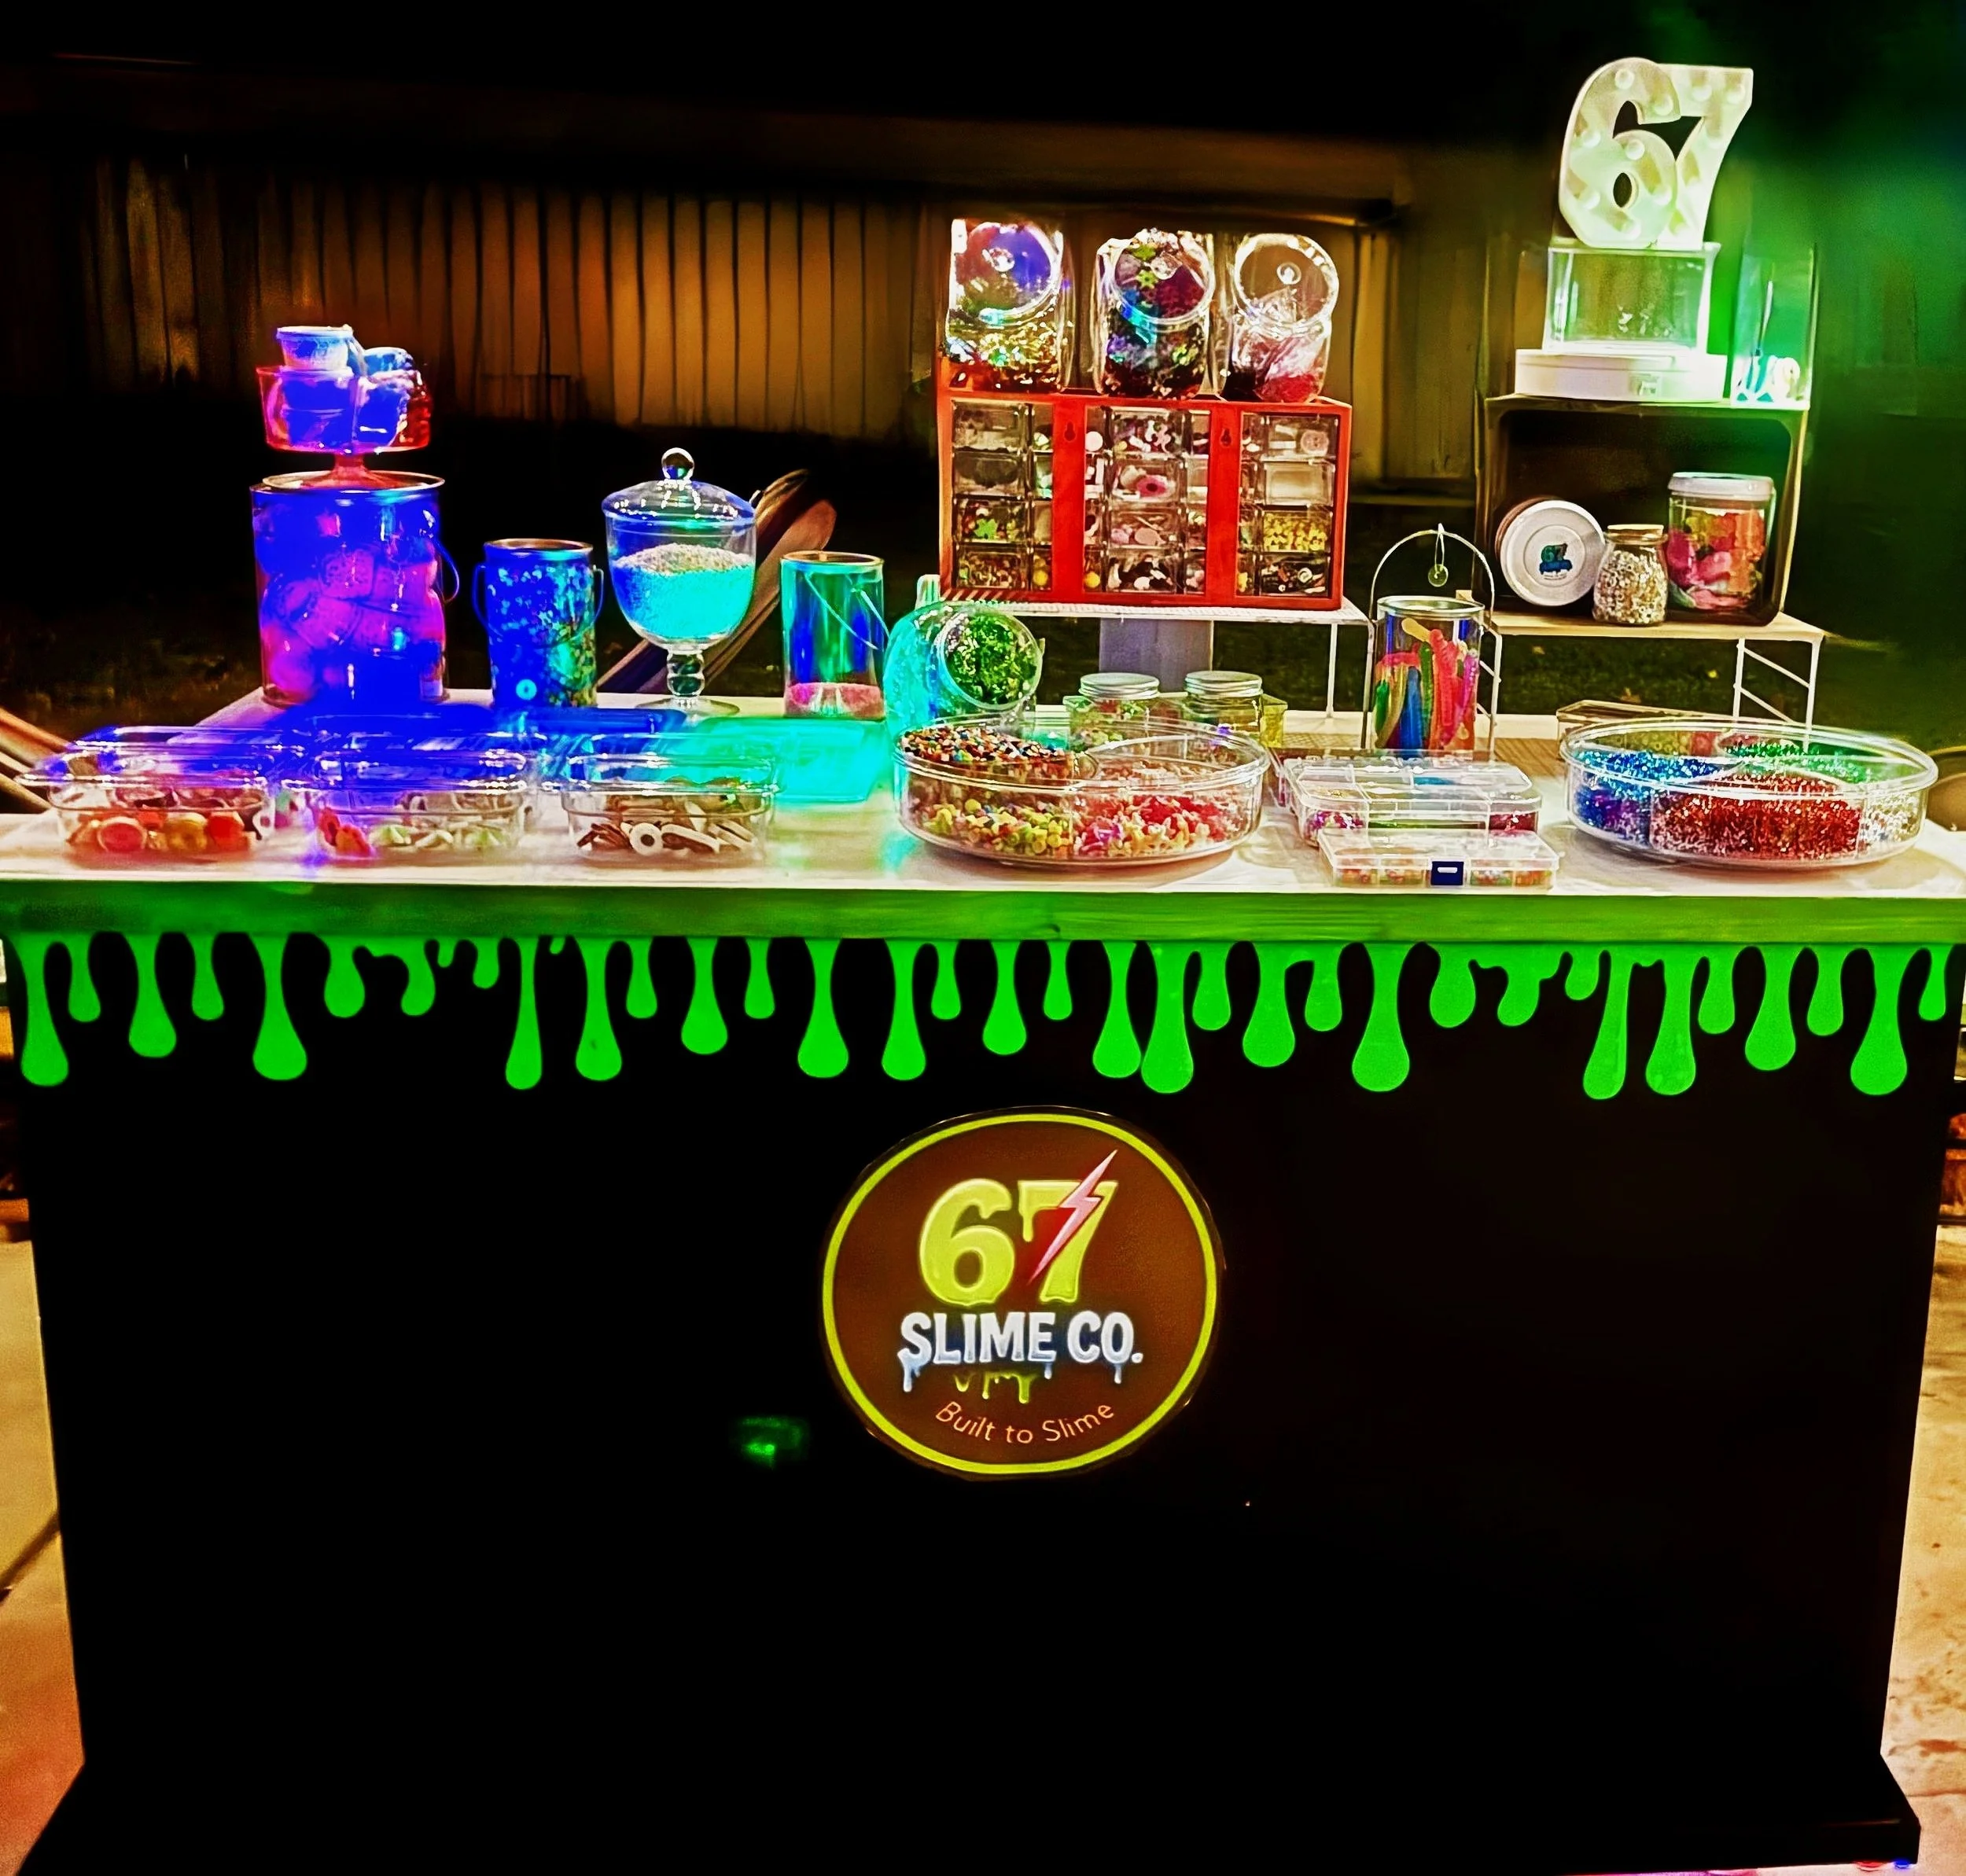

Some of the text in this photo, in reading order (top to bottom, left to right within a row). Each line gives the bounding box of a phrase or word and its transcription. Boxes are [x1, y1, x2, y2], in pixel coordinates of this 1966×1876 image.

[1559, 57, 1754, 250] 67
[919, 1178, 1118, 1306] 67
[897, 1310, 1143, 1372] SLIME CO.
[936, 1401, 1114, 1444] Built to Slime
